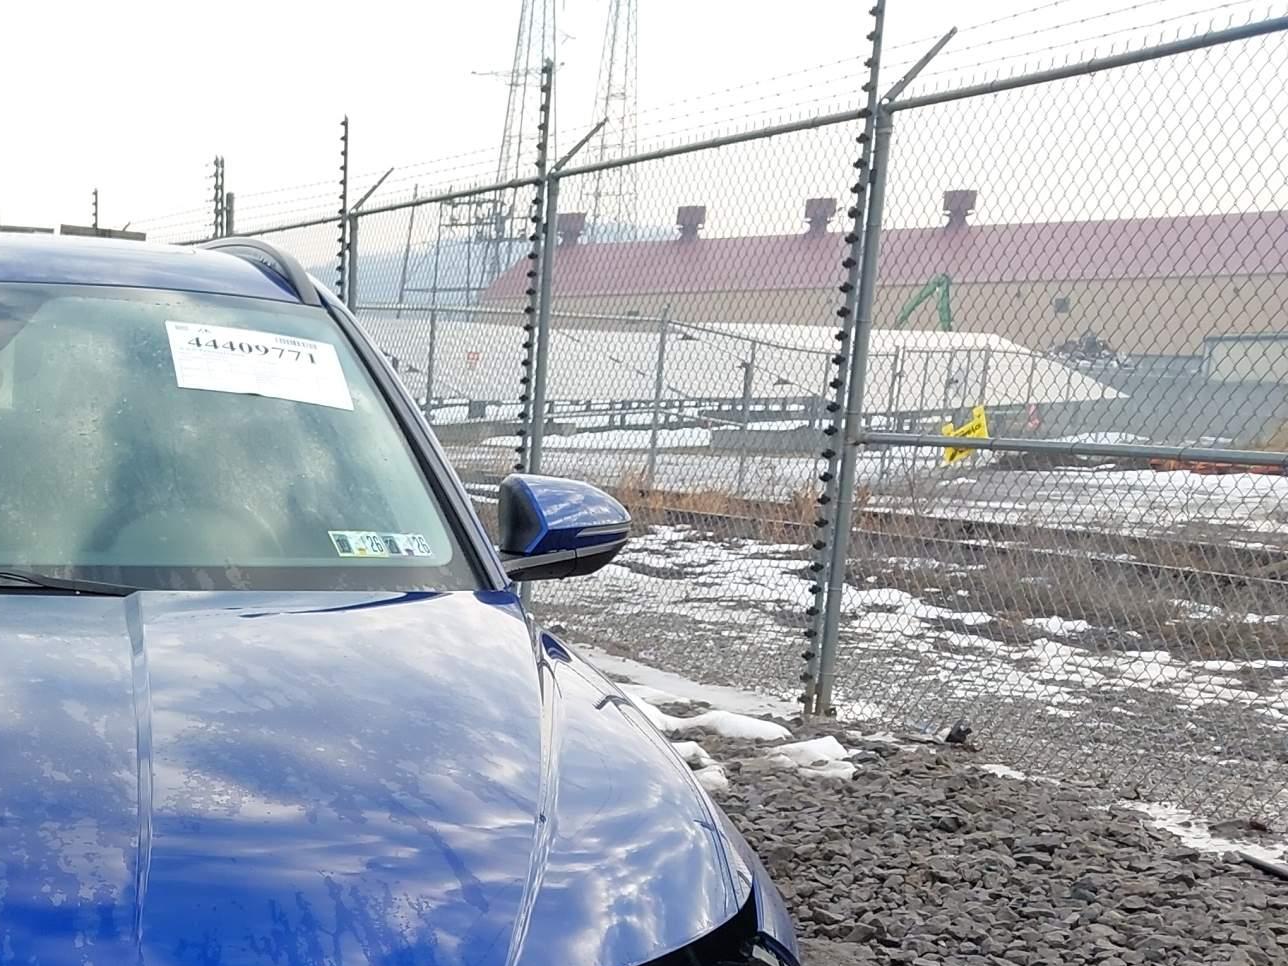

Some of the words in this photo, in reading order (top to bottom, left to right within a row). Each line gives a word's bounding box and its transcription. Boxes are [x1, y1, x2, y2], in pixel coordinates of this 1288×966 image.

[187, 336, 317, 365] 44409771
[366, 535, 384, 553] 26
[412, 536, 431, 554] 26
